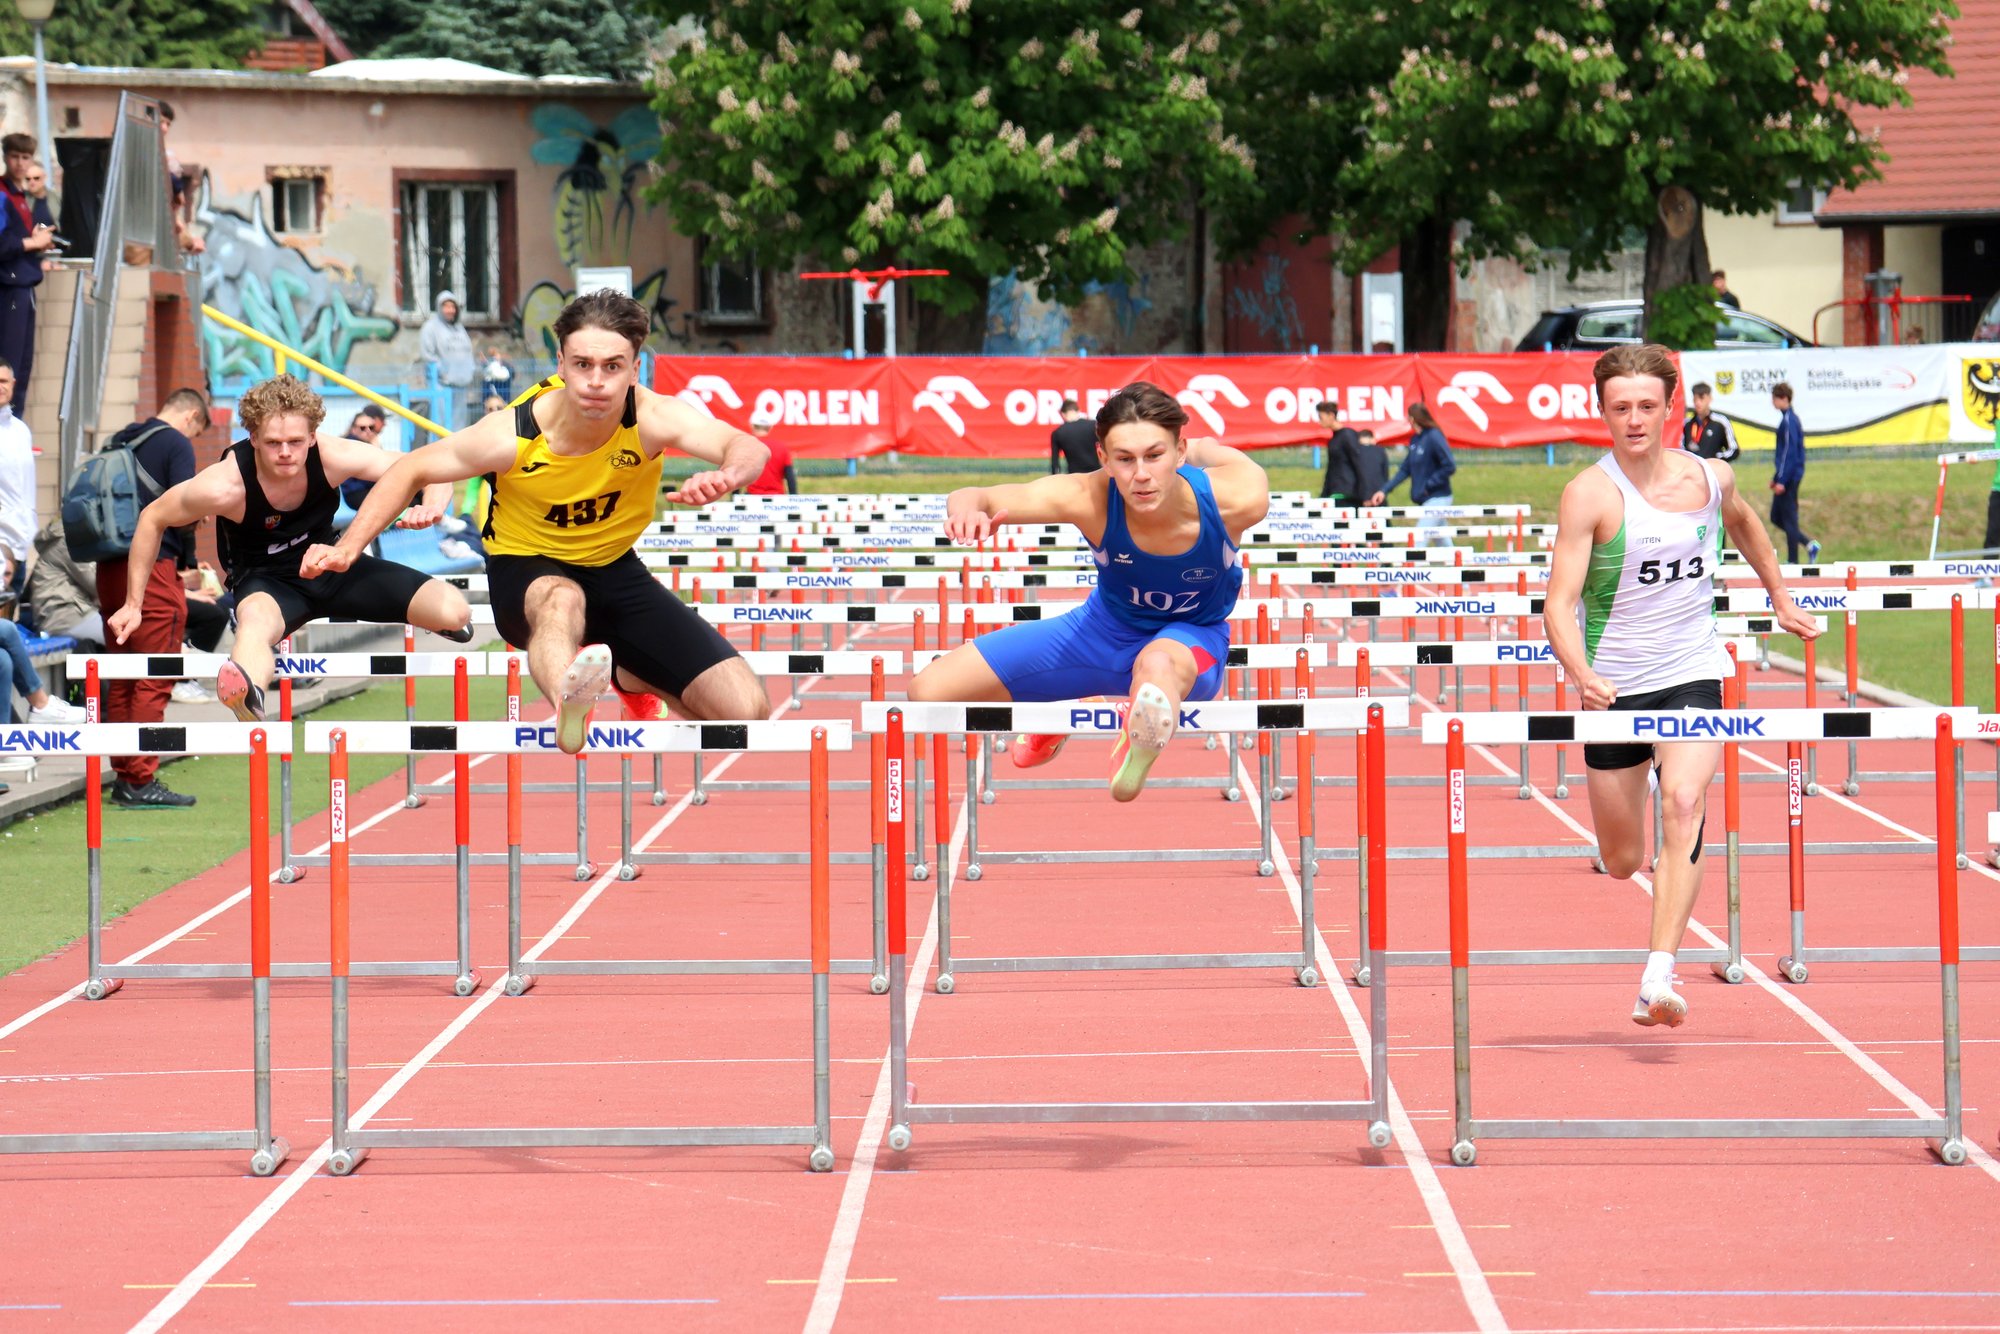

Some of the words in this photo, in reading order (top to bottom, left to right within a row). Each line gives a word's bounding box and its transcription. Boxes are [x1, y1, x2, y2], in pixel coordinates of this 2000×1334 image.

[1741, 368, 1787, 381] DOLNY
[1808, 368, 1844, 379] Koleje
[755, 389, 879, 425] ORLEN
[544, 490, 621, 528] 437
[695, 525, 740, 533] POLANIK
[890, 525, 934, 533] POLANIK
[644, 538, 693, 546] POLANIK
[863, 538, 913, 546] POLANIK
[1293, 533, 1342, 541] POLANIK
[833, 556, 889, 566] POLANIK
[1323, 551, 1380, 561] POLANIK
[1365, 571, 1431, 582] POLANIK
[1637, 556, 1704, 585] 513
[787, 576, 853, 587] POLANIK
[734, 607, 813, 621] POLANIK
[1497, 645, 1559, 661] POLA
[275, 658, 327, 673] ANIK
[88, 698, 96, 723] POLA
[1634, 716, 1765, 737] POLANIK
[515, 727, 645, 748] PONIK
[890, 761, 899, 814] POLANIK
[1791, 760, 1799, 810] POLANIK
[1453, 771, 1462, 825] POLANIK
[333, 781, 343, 834] POLANIK
